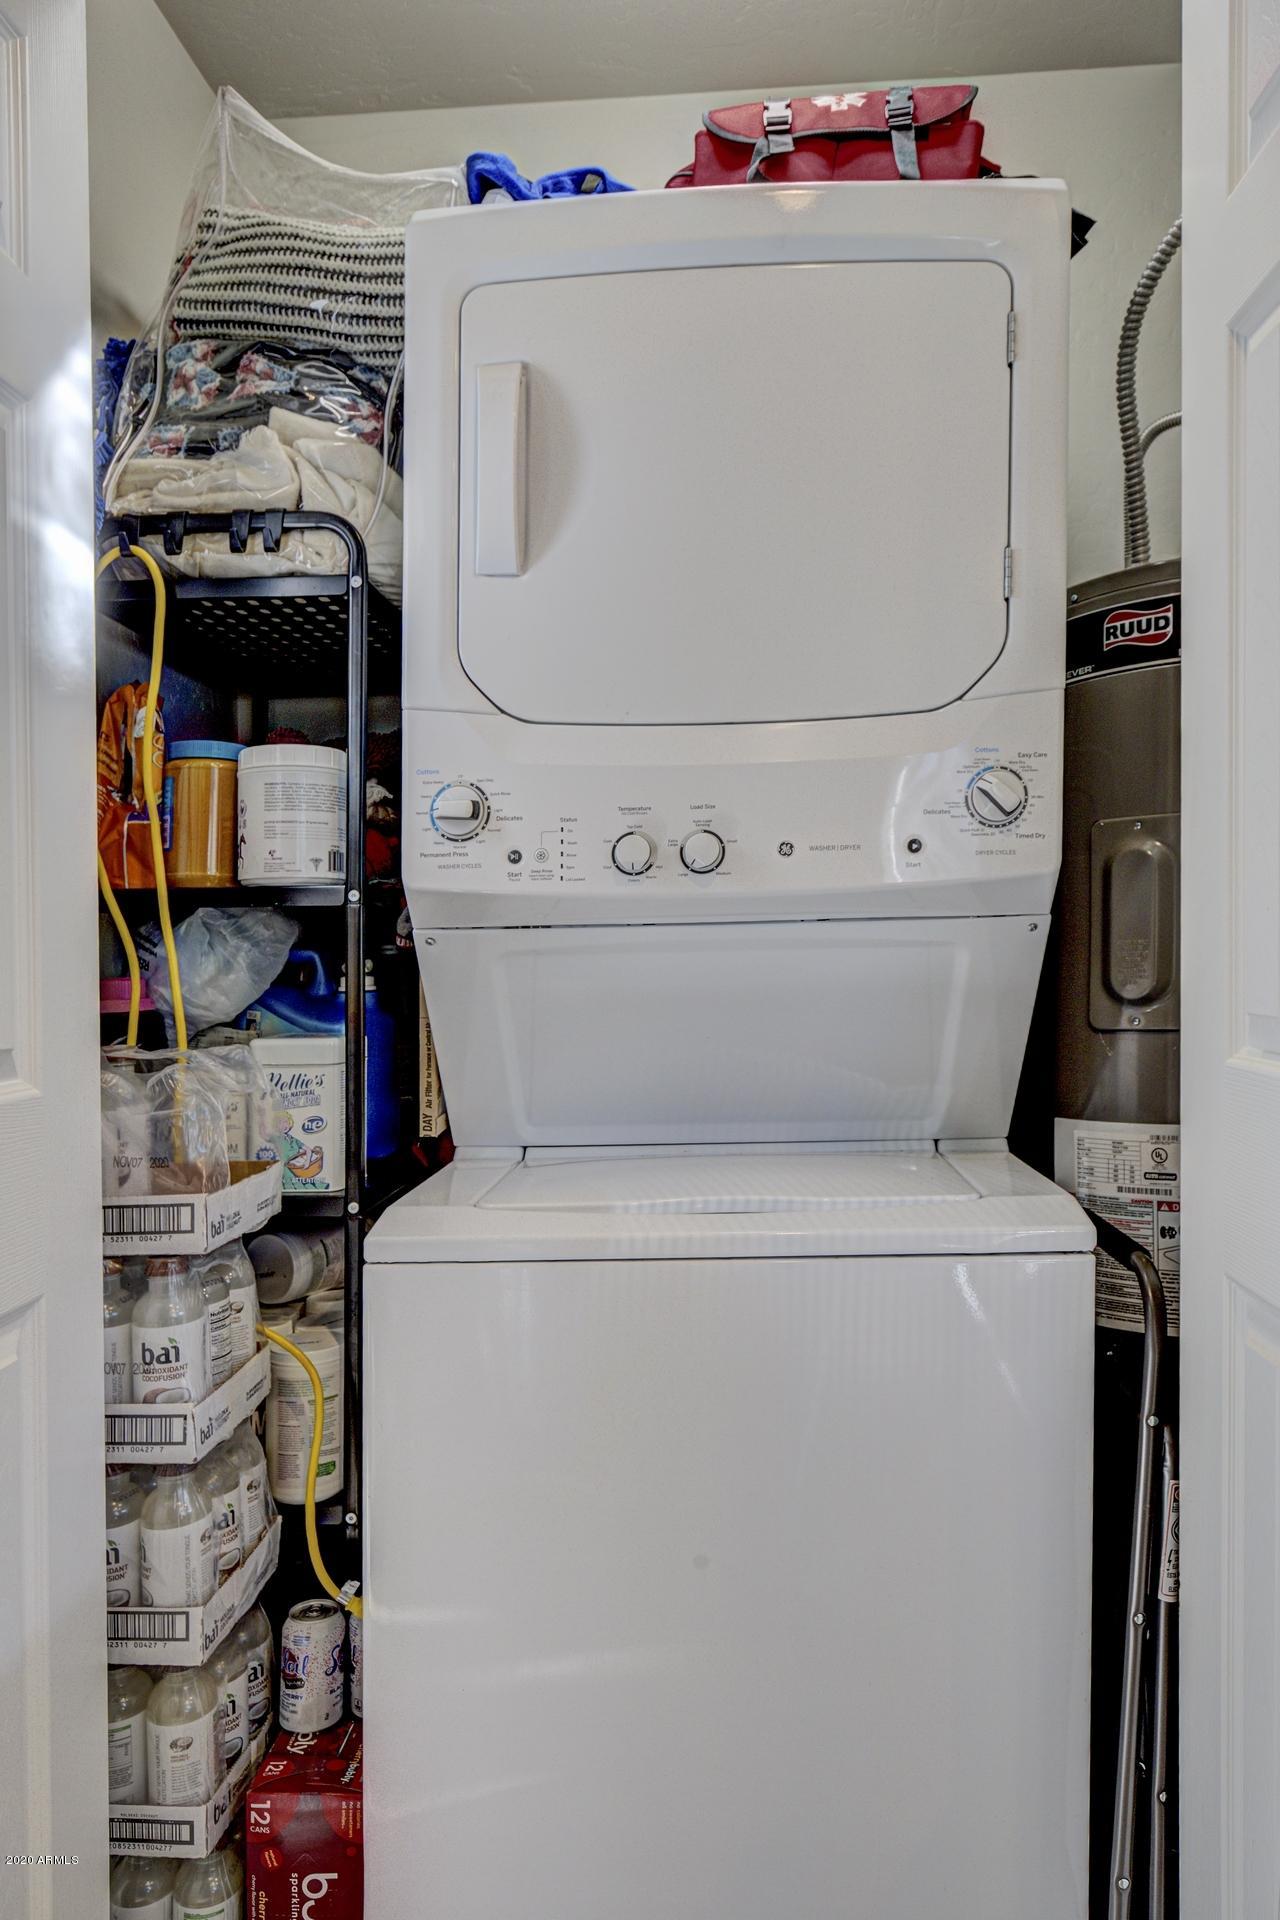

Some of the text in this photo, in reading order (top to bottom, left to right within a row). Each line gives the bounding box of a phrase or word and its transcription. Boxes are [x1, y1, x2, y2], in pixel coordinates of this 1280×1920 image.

[1105, 615, 1170, 641] RUUD
[266, 1072, 326, 1091] Nellie's
[291, 1089, 315, 1098] NATURAL
[423, 1113, 433, 1131] DAY
[211, 1214, 225, 1239] bai
[141, 1337, 180, 1365] bai
[200, 1417, 213, 1445] bai
[265, 1761, 287, 1772] 12
[250, 1800, 271, 1825] 12
[250, 1826, 270, 1834] CANS
